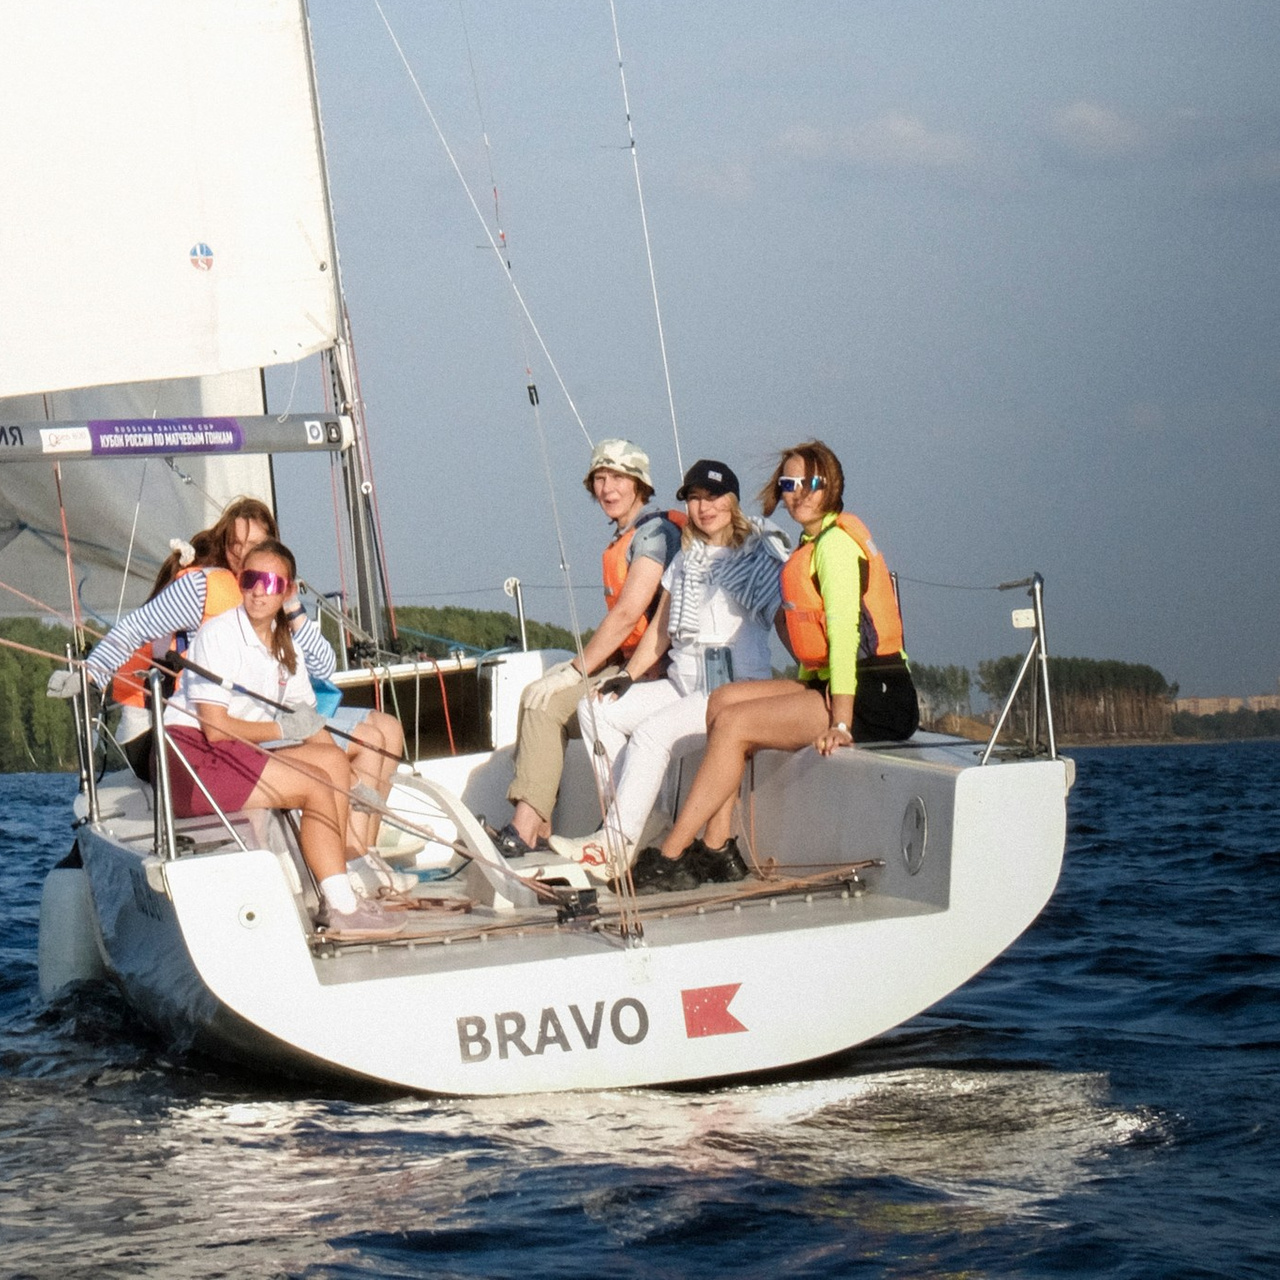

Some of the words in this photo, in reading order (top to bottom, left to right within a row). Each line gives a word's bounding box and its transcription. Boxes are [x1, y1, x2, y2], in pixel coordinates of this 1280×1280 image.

[114, 425, 153, 433] RUSSIAN
[157, 424, 193, 432] SAILING
[100, 434, 125, 448] КУБОК
[124, 433, 153, 447] РОССИИ
[153, 432, 164, 446] ПО
[456, 997, 649, 1064] BRAVO
